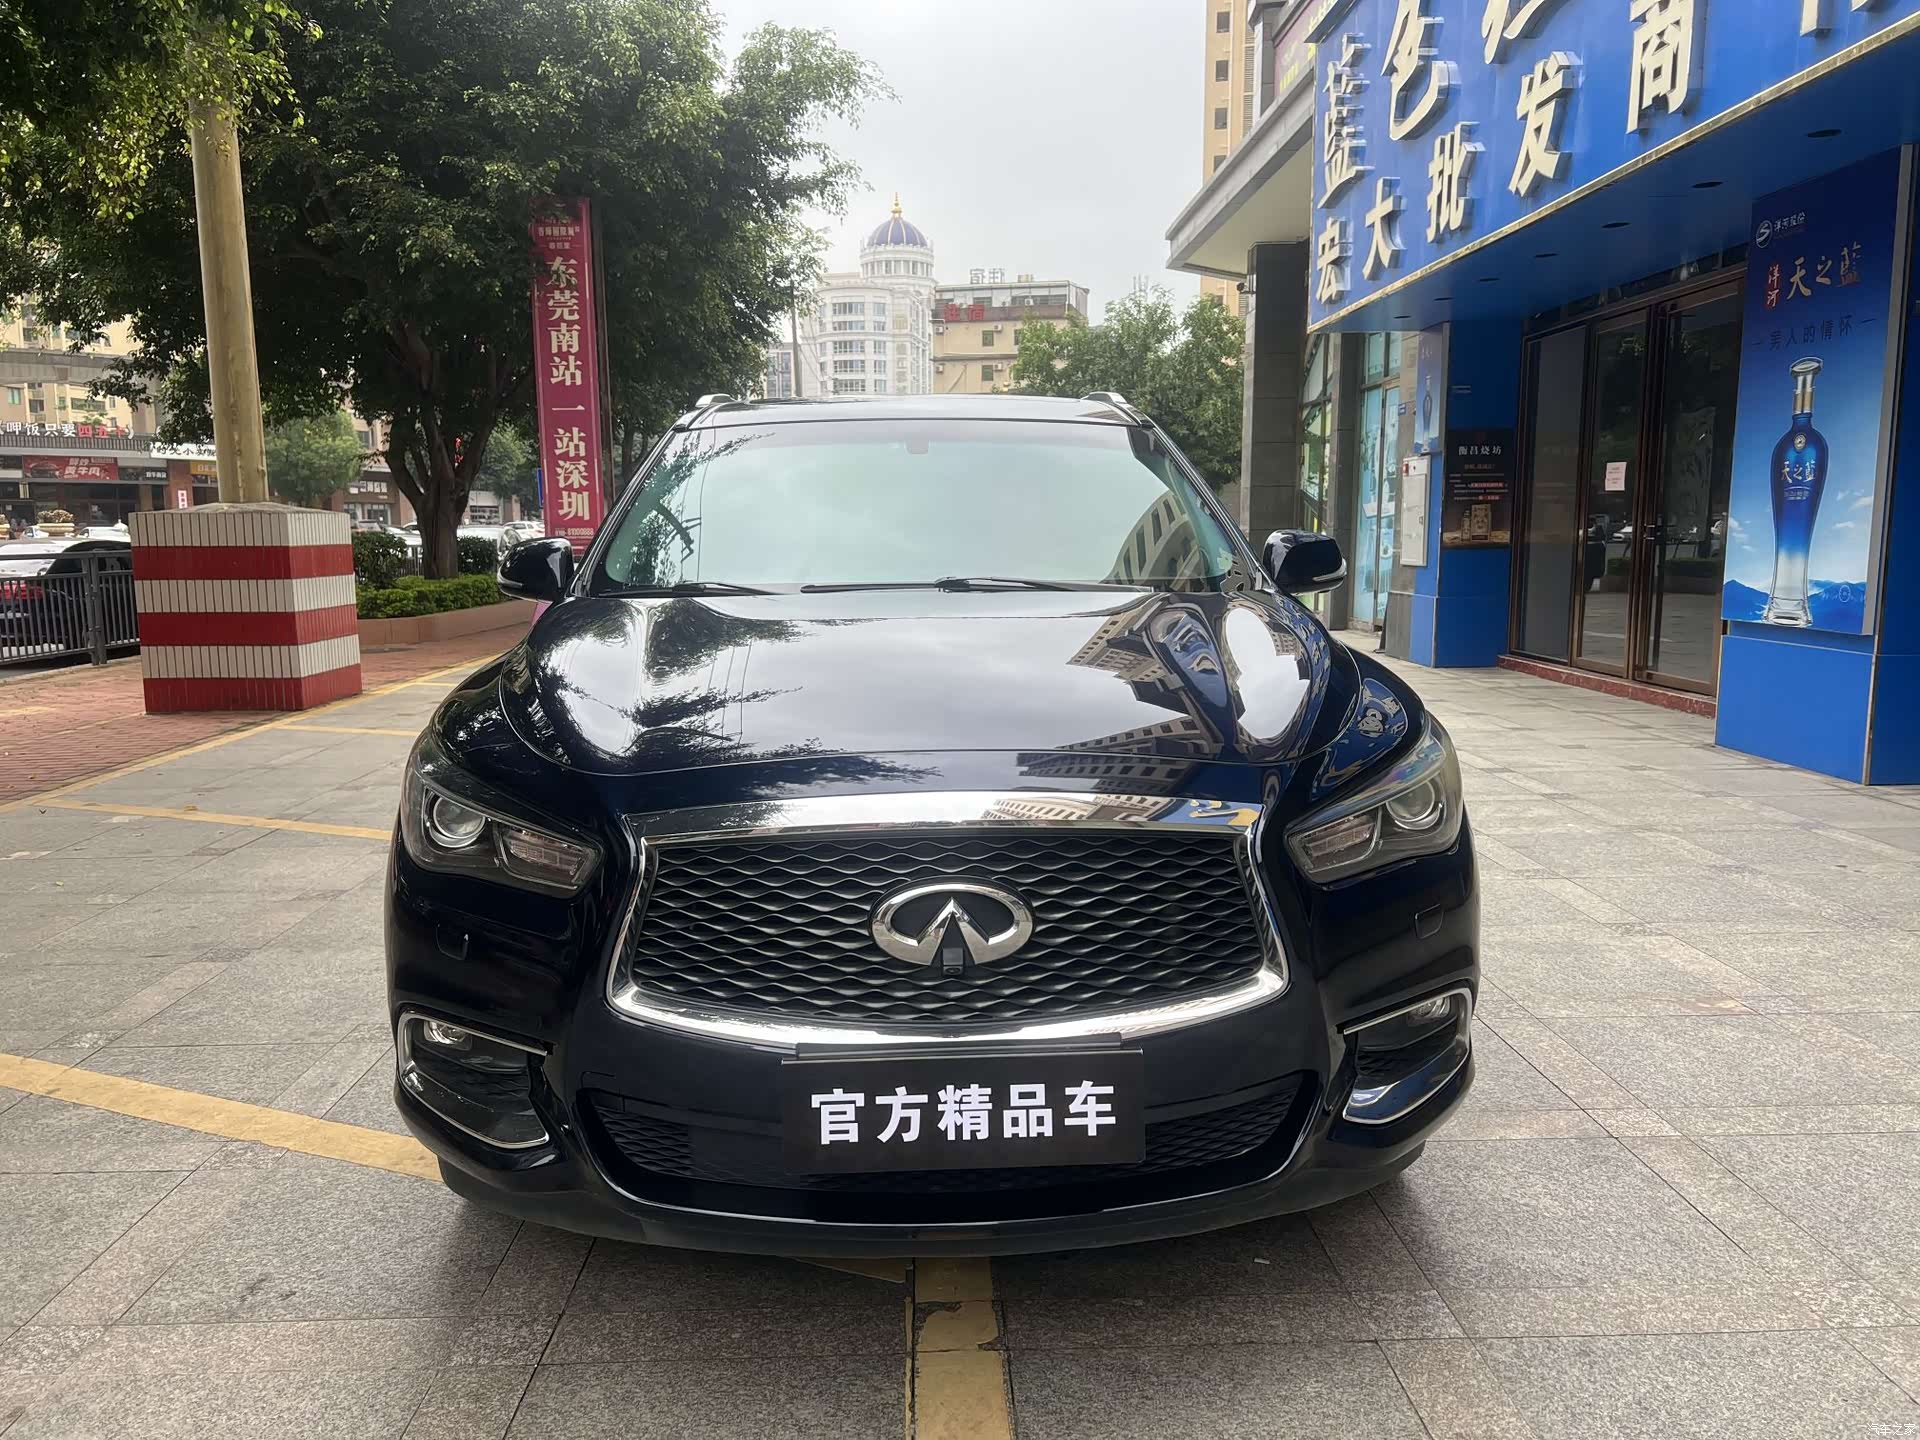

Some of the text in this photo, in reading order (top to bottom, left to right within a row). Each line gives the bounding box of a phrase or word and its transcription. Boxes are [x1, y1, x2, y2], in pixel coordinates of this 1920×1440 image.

[1315, 0, 1884, 304] 宏大批发商
[1766, 263, 1781, 307] 洋河
[810, 1079, 1117, 1145] 官方精品车
